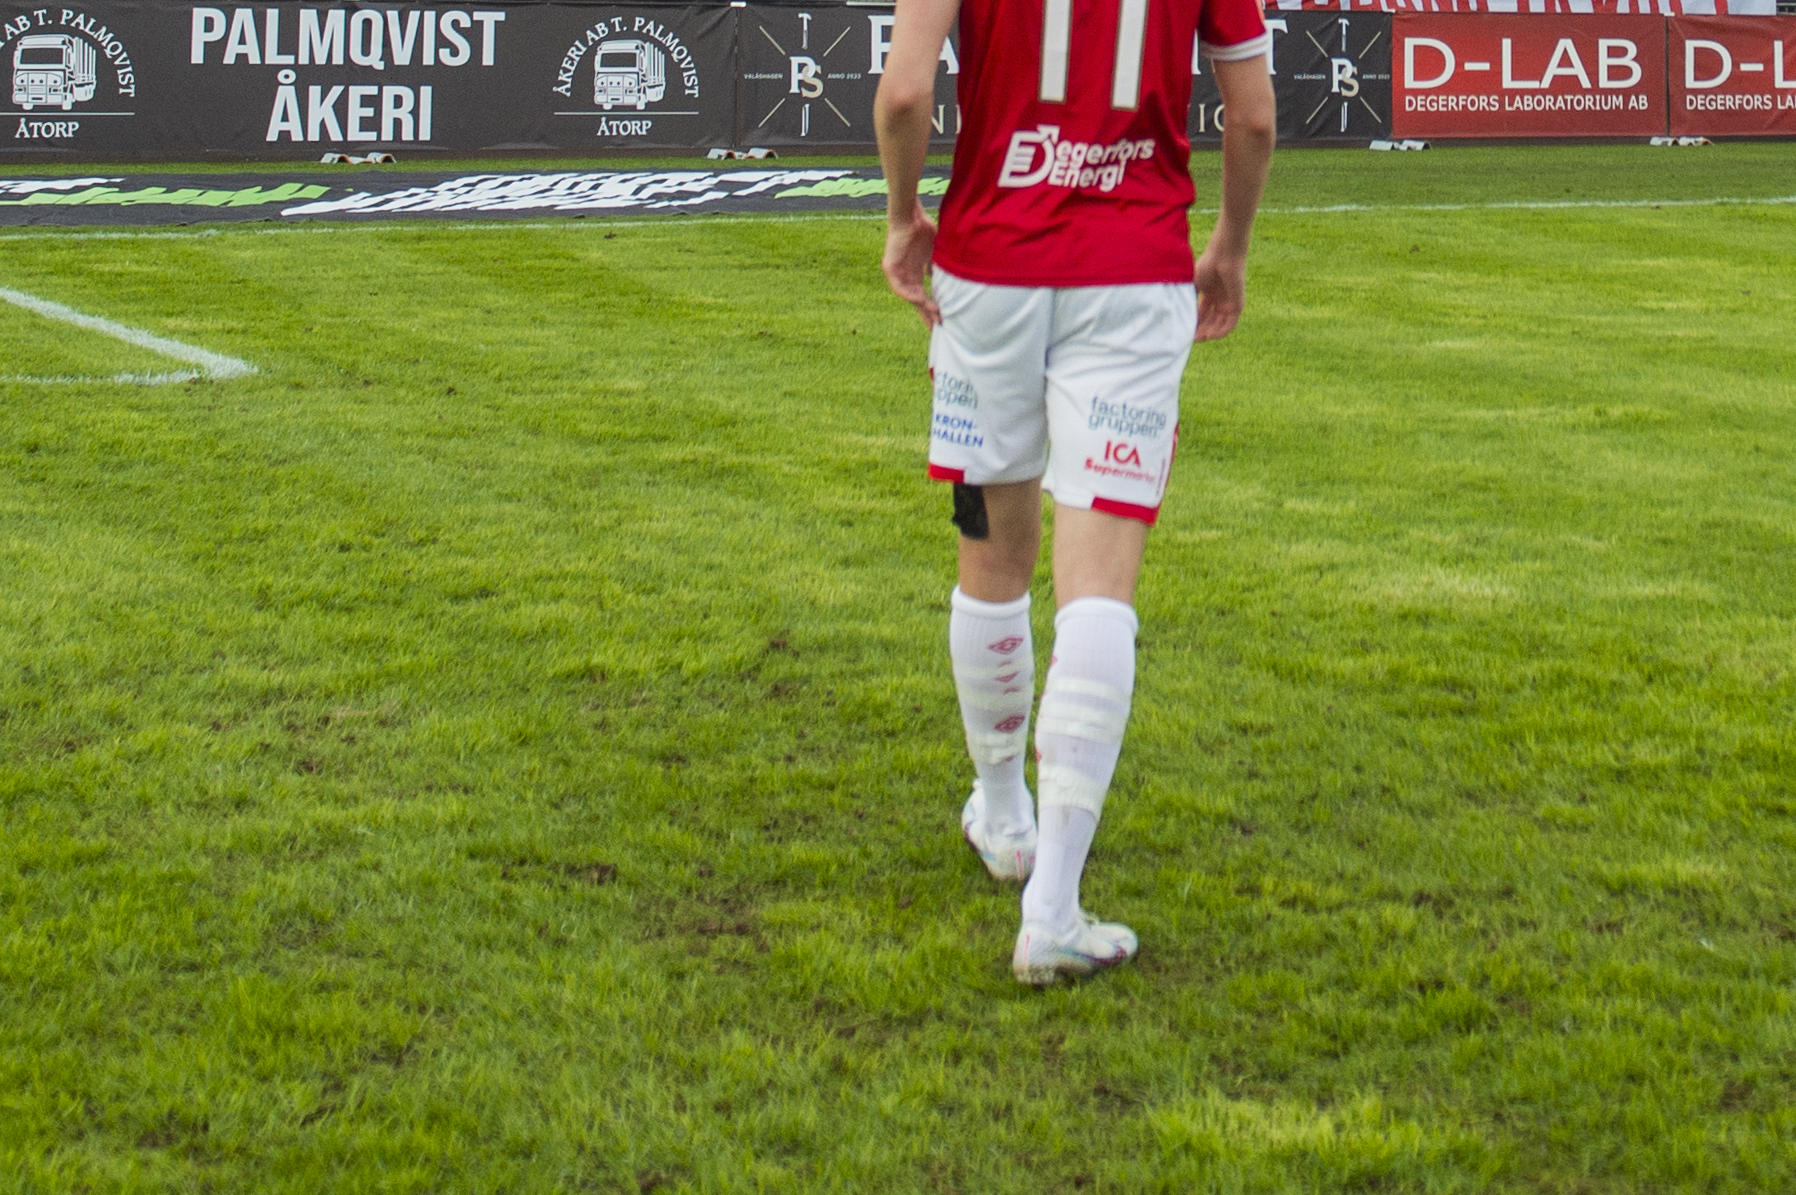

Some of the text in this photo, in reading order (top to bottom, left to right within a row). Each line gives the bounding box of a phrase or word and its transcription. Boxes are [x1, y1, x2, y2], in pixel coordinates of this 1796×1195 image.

[190, 8, 506, 67] PALMQVIST
[3, 8, 136, 97] AB T. PALMQVIST
[553, 17, 700, 98] ÅKERI AB T. PALMQVIST
[1403, 36, 1642, 90] D-LAB
[266, 68, 432, 142] ÅKERI
[1405, 94, 1649, 112] DEGERFORS LABORATORIUM AB
[1686, 94, 1773, 111] DEGERFORS
[15, 117, 79, 139] ÅTORP
[597, 116, 652, 136] ÅTORP
[935, 413, 979, 432] KRON-
[1091, 396, 1167, 429] factoring
[933, 427, 984, 449] HALLEN
[1087, 414, 1160, 439] gruppen
[1105, 440, 1141, 468] ICA
